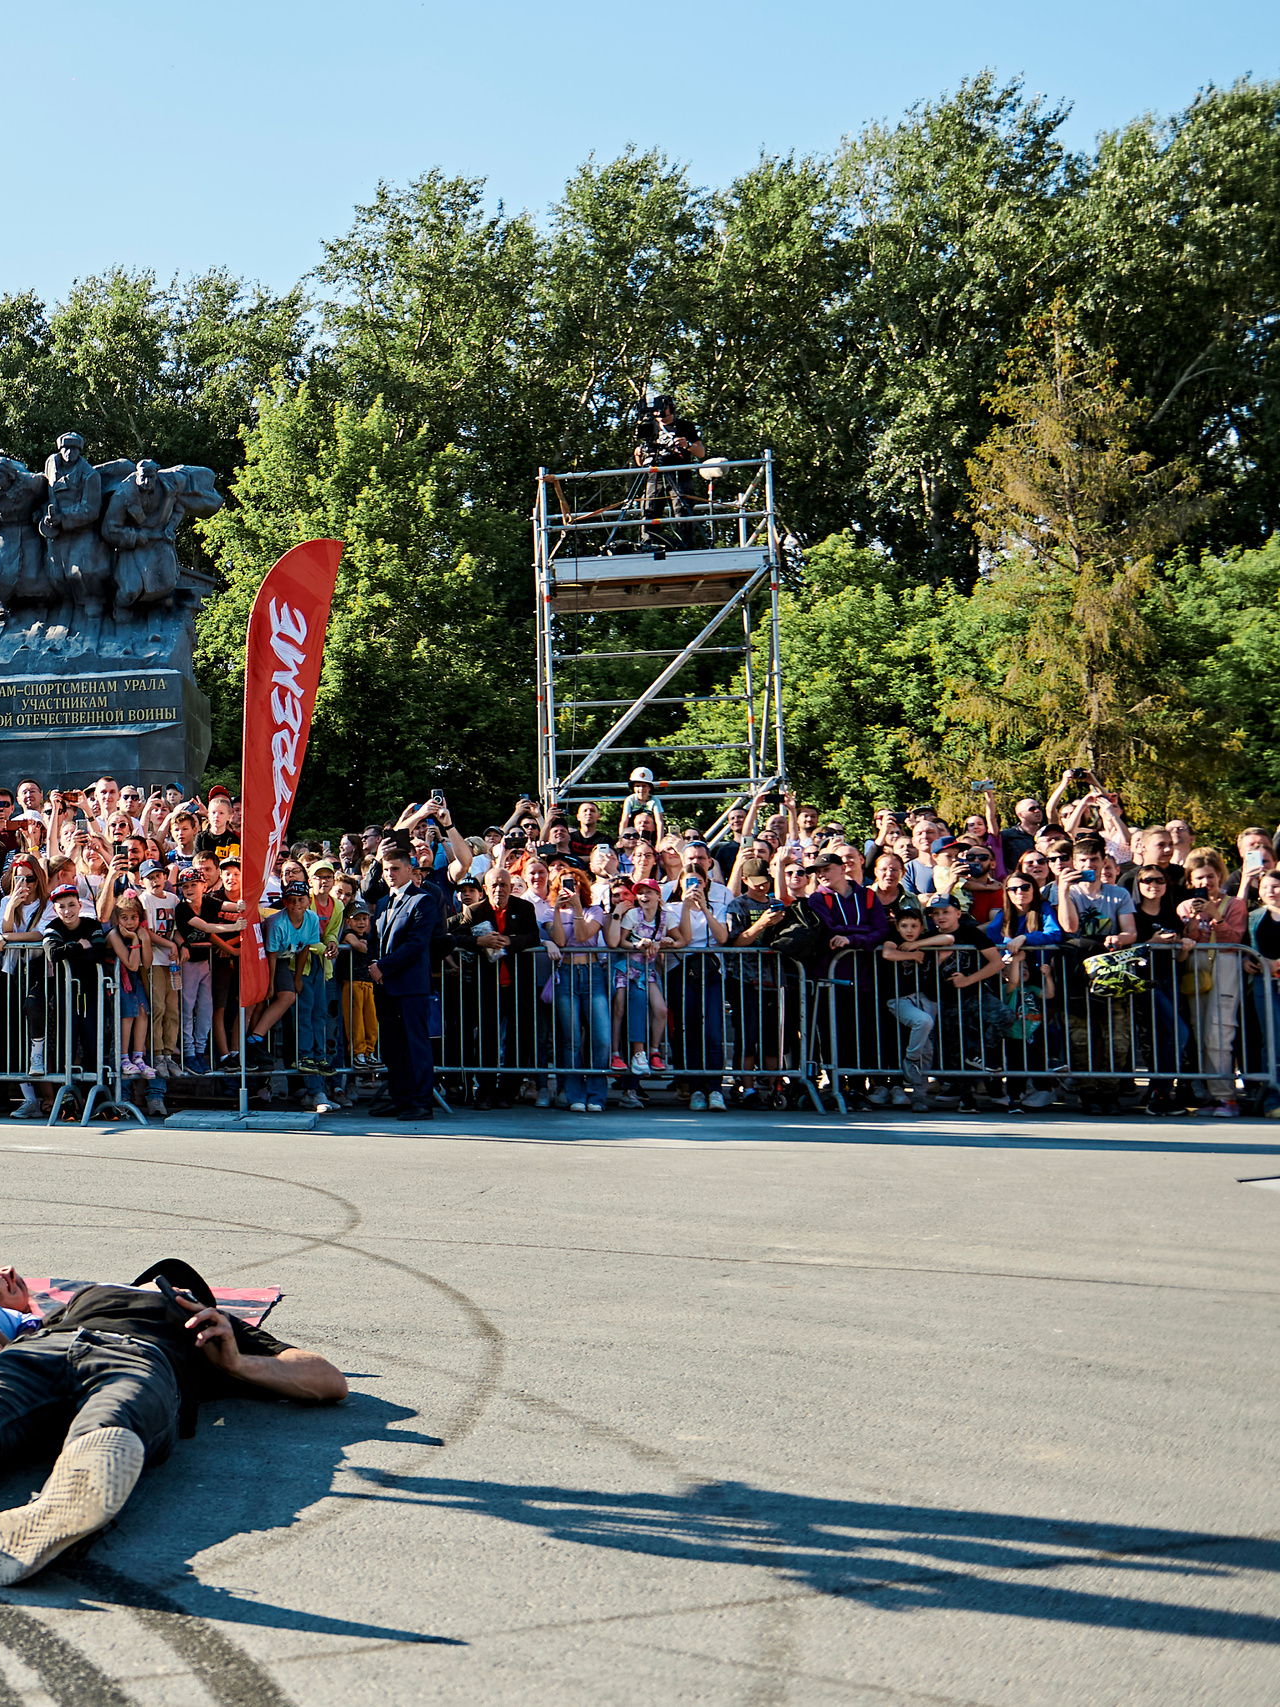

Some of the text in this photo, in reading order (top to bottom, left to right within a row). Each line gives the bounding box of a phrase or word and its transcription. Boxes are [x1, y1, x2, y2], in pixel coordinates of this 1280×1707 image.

[123, 677, 167, 692] УРАЛА
[21, 695, 108, 711] УЧАСТНИКАМ
[16, 707, 125, 727] ОТЕЧЕСТВЕННОЙ
[128, 706, 177, 722] ВОИНЫ
[261, 596, 308, 882] XTREME
